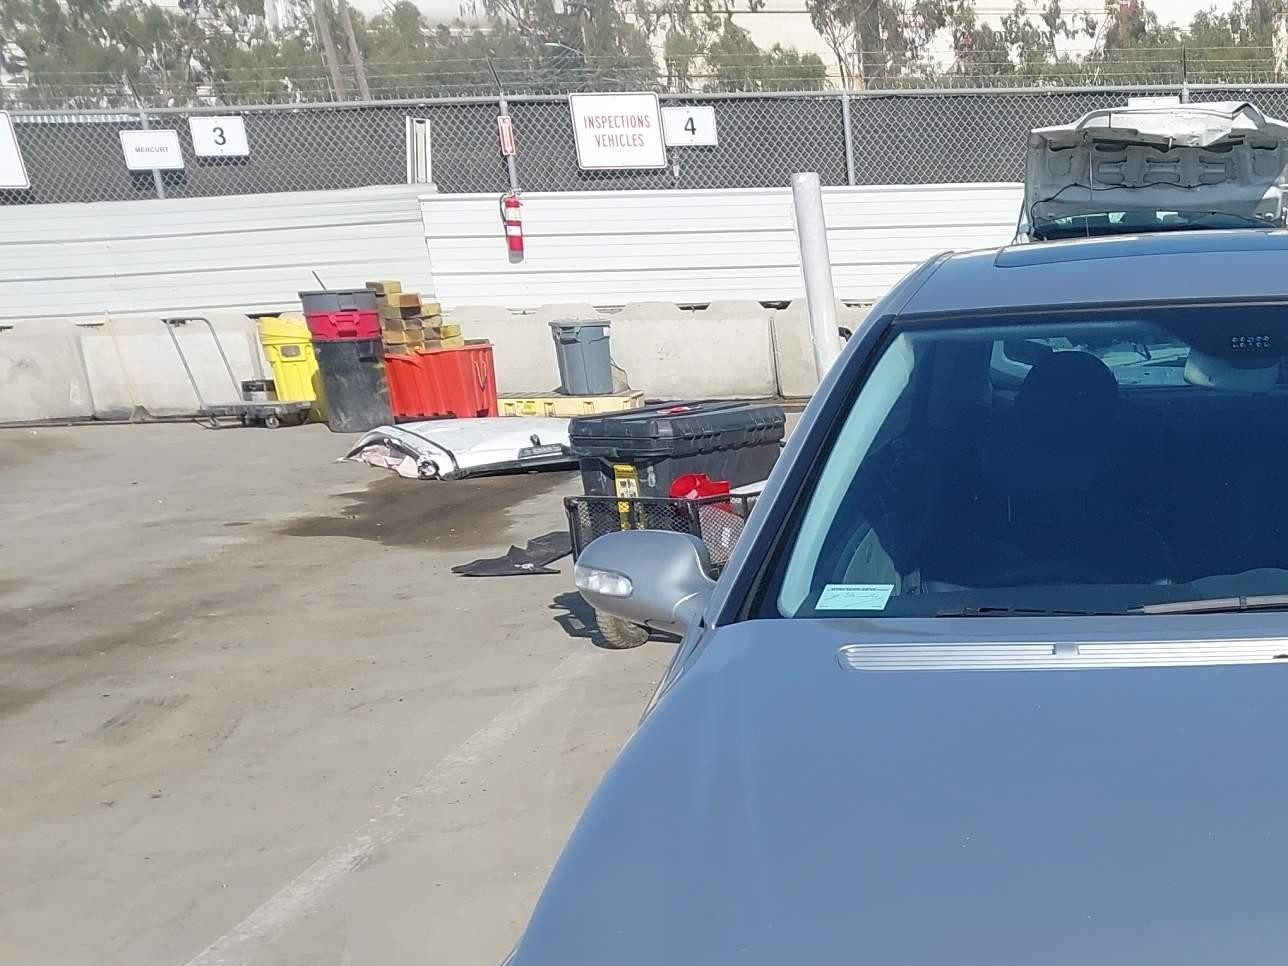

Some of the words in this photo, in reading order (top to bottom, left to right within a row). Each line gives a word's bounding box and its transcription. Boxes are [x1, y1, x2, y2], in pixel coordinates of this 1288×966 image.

[583, 115, 651, 129] INSPECTIONS
[683, 116, 697, 136] 4
[212, 127, 226, 145] 3
[594, 133, 645, 148] VEHICLES
